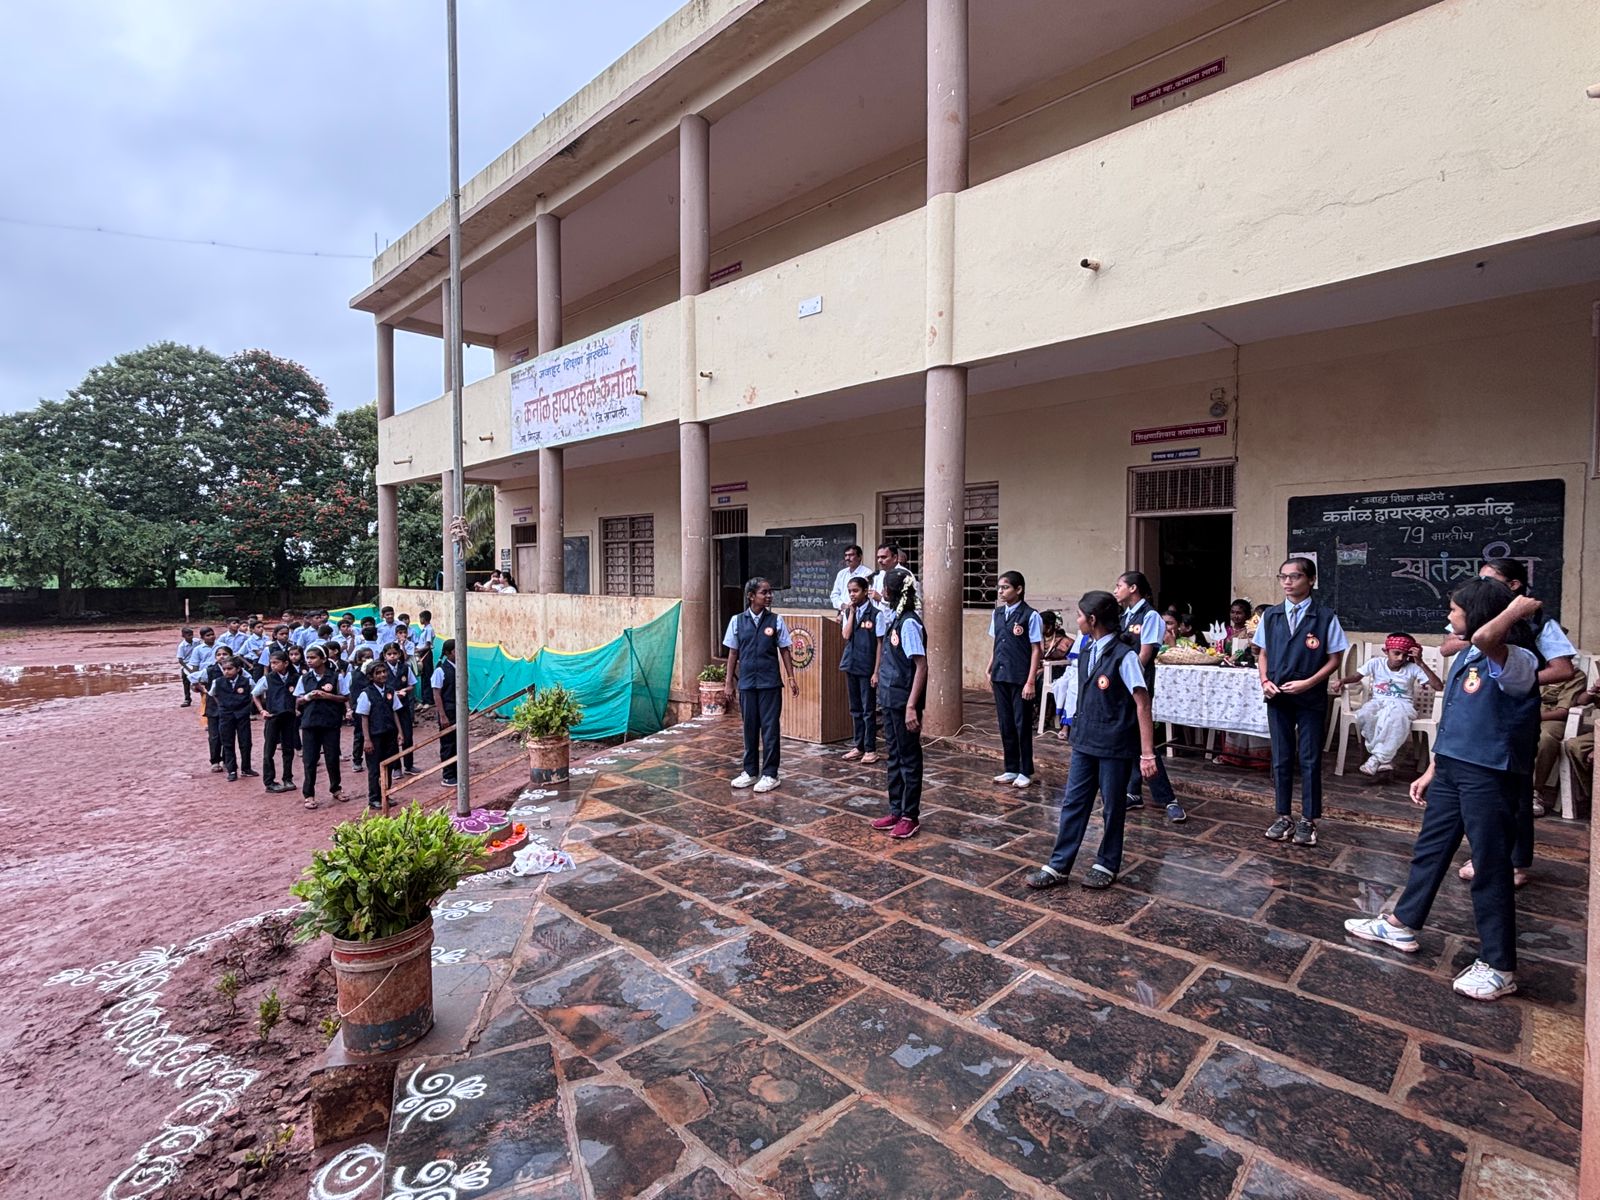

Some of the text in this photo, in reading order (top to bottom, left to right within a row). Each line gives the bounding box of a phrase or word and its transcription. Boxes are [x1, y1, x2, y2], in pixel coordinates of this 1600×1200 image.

[1361, 496, 1388, 505] जवाहर
[1391, 492, 1414, 503] शिक्षण
[1322, 505, 1373, 523] कर्नाळ
[1454, 497, 1515, 517] कर्नाळ
[1398, 525, 1475, 544] 79 भारतीय
